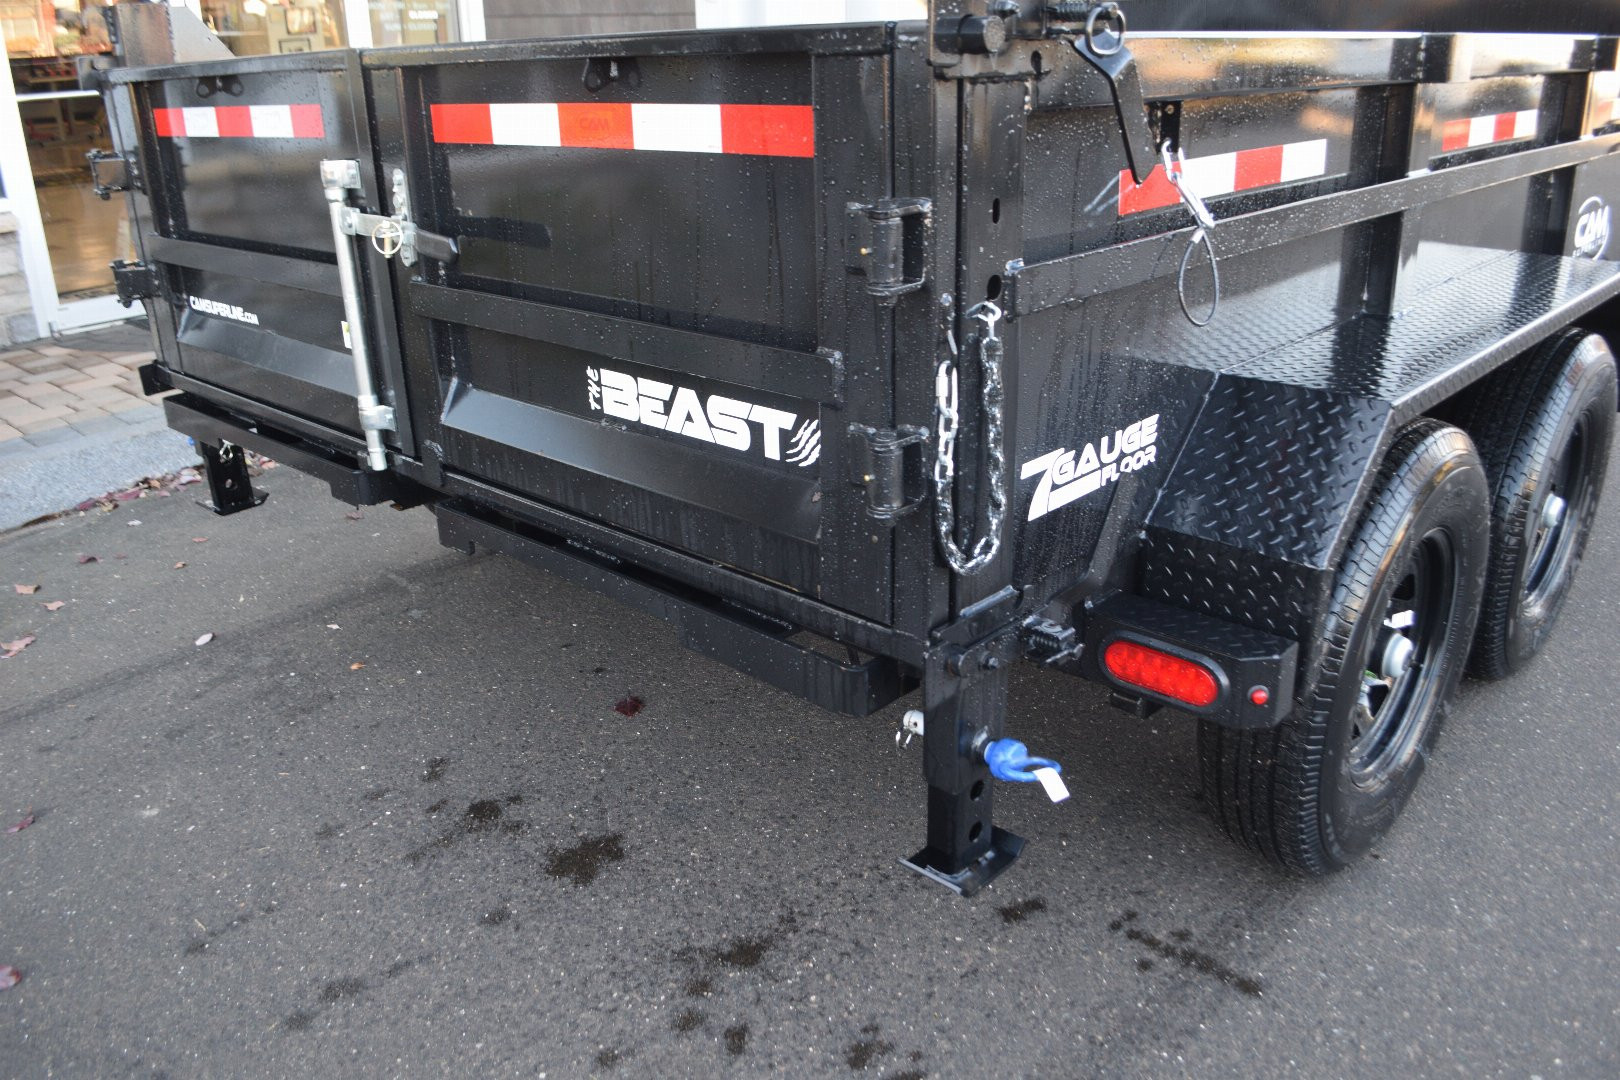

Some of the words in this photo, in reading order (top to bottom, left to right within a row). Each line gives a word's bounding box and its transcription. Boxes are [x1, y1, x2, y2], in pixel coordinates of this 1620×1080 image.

[586, 365, 601, 411] THE
[600, 368, 797, 461] BEAST
[1020, 447, 1066, 521] 7
[1052, 413, 1160, 485] GAUGE
[1100, 444, 1157, 487] FLOOR
